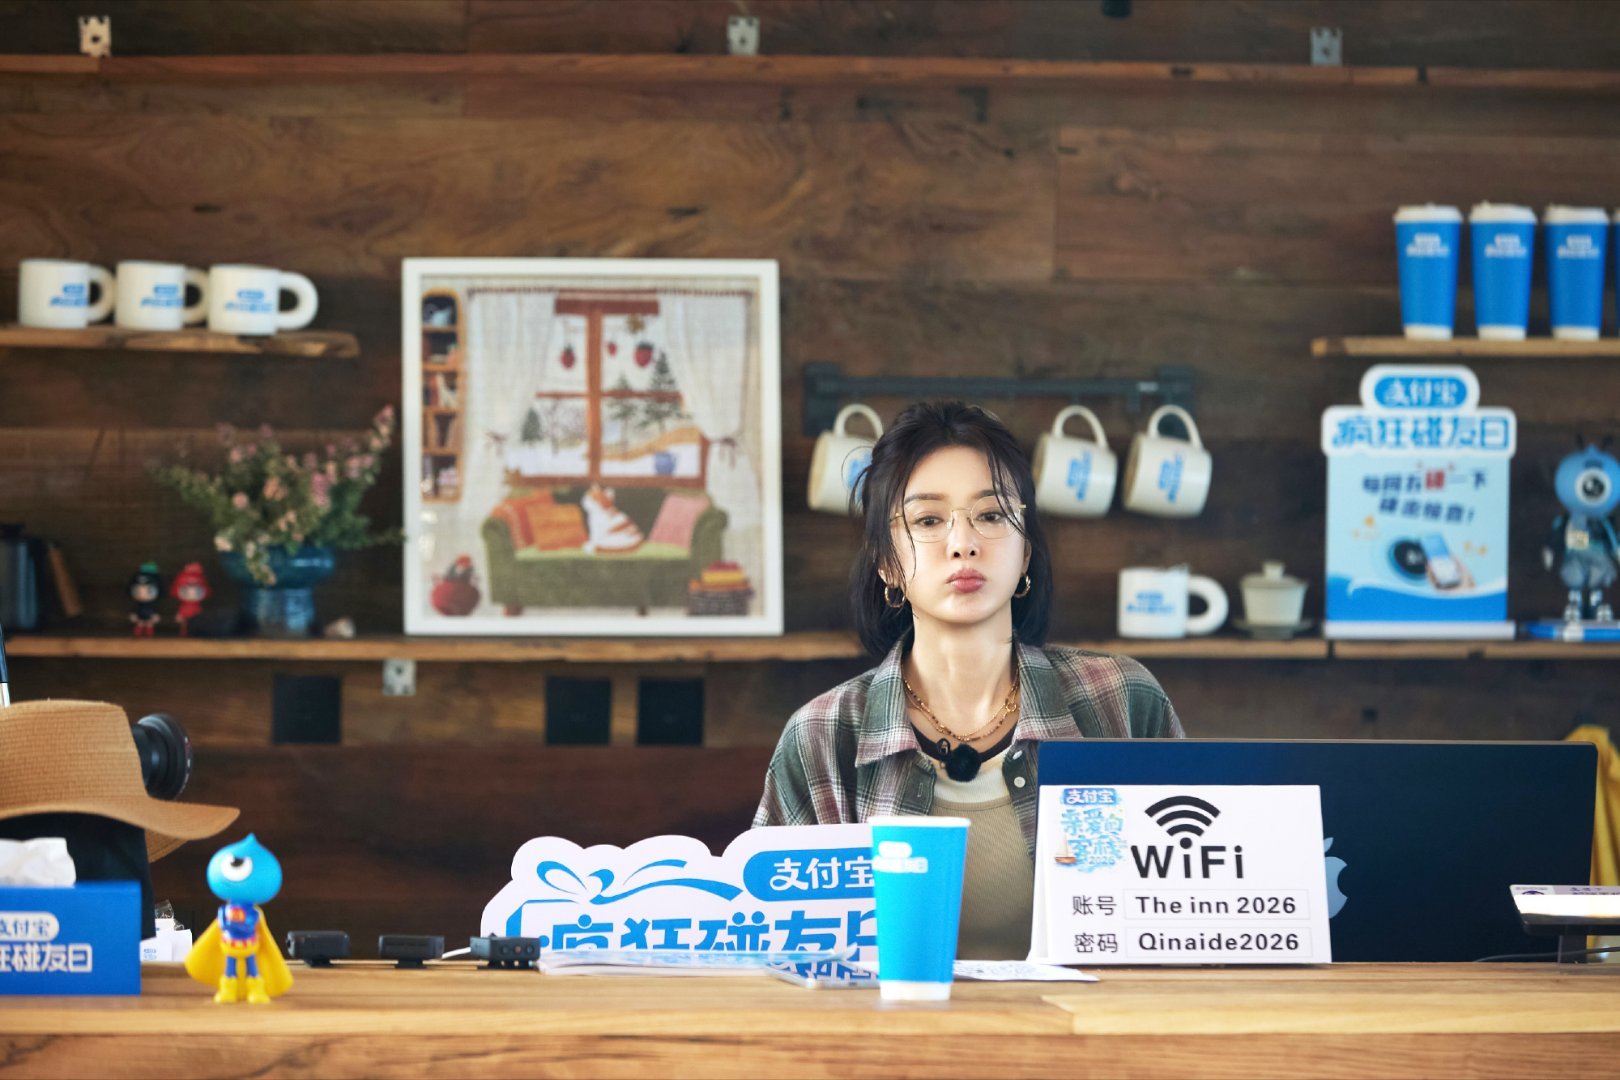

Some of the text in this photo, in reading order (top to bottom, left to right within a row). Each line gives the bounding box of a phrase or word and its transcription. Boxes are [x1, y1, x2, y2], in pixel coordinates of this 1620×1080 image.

[1384, 377, 1459, 407] 支付宝
[1332, 415, 1509, 450] 疯狂碰友日
[1066, 788, 1115, 804] 支付宝
[1061, 807, 1124, 836] 亲爱的
[1130, 837, 1244, 879] WiFi
[769, 855, 876, 891] 支付宝
[1072, 895, 1297, 916] 账号 The inn 2026
[1074, 932, 1299, 953] 密码 Qinaide2026
